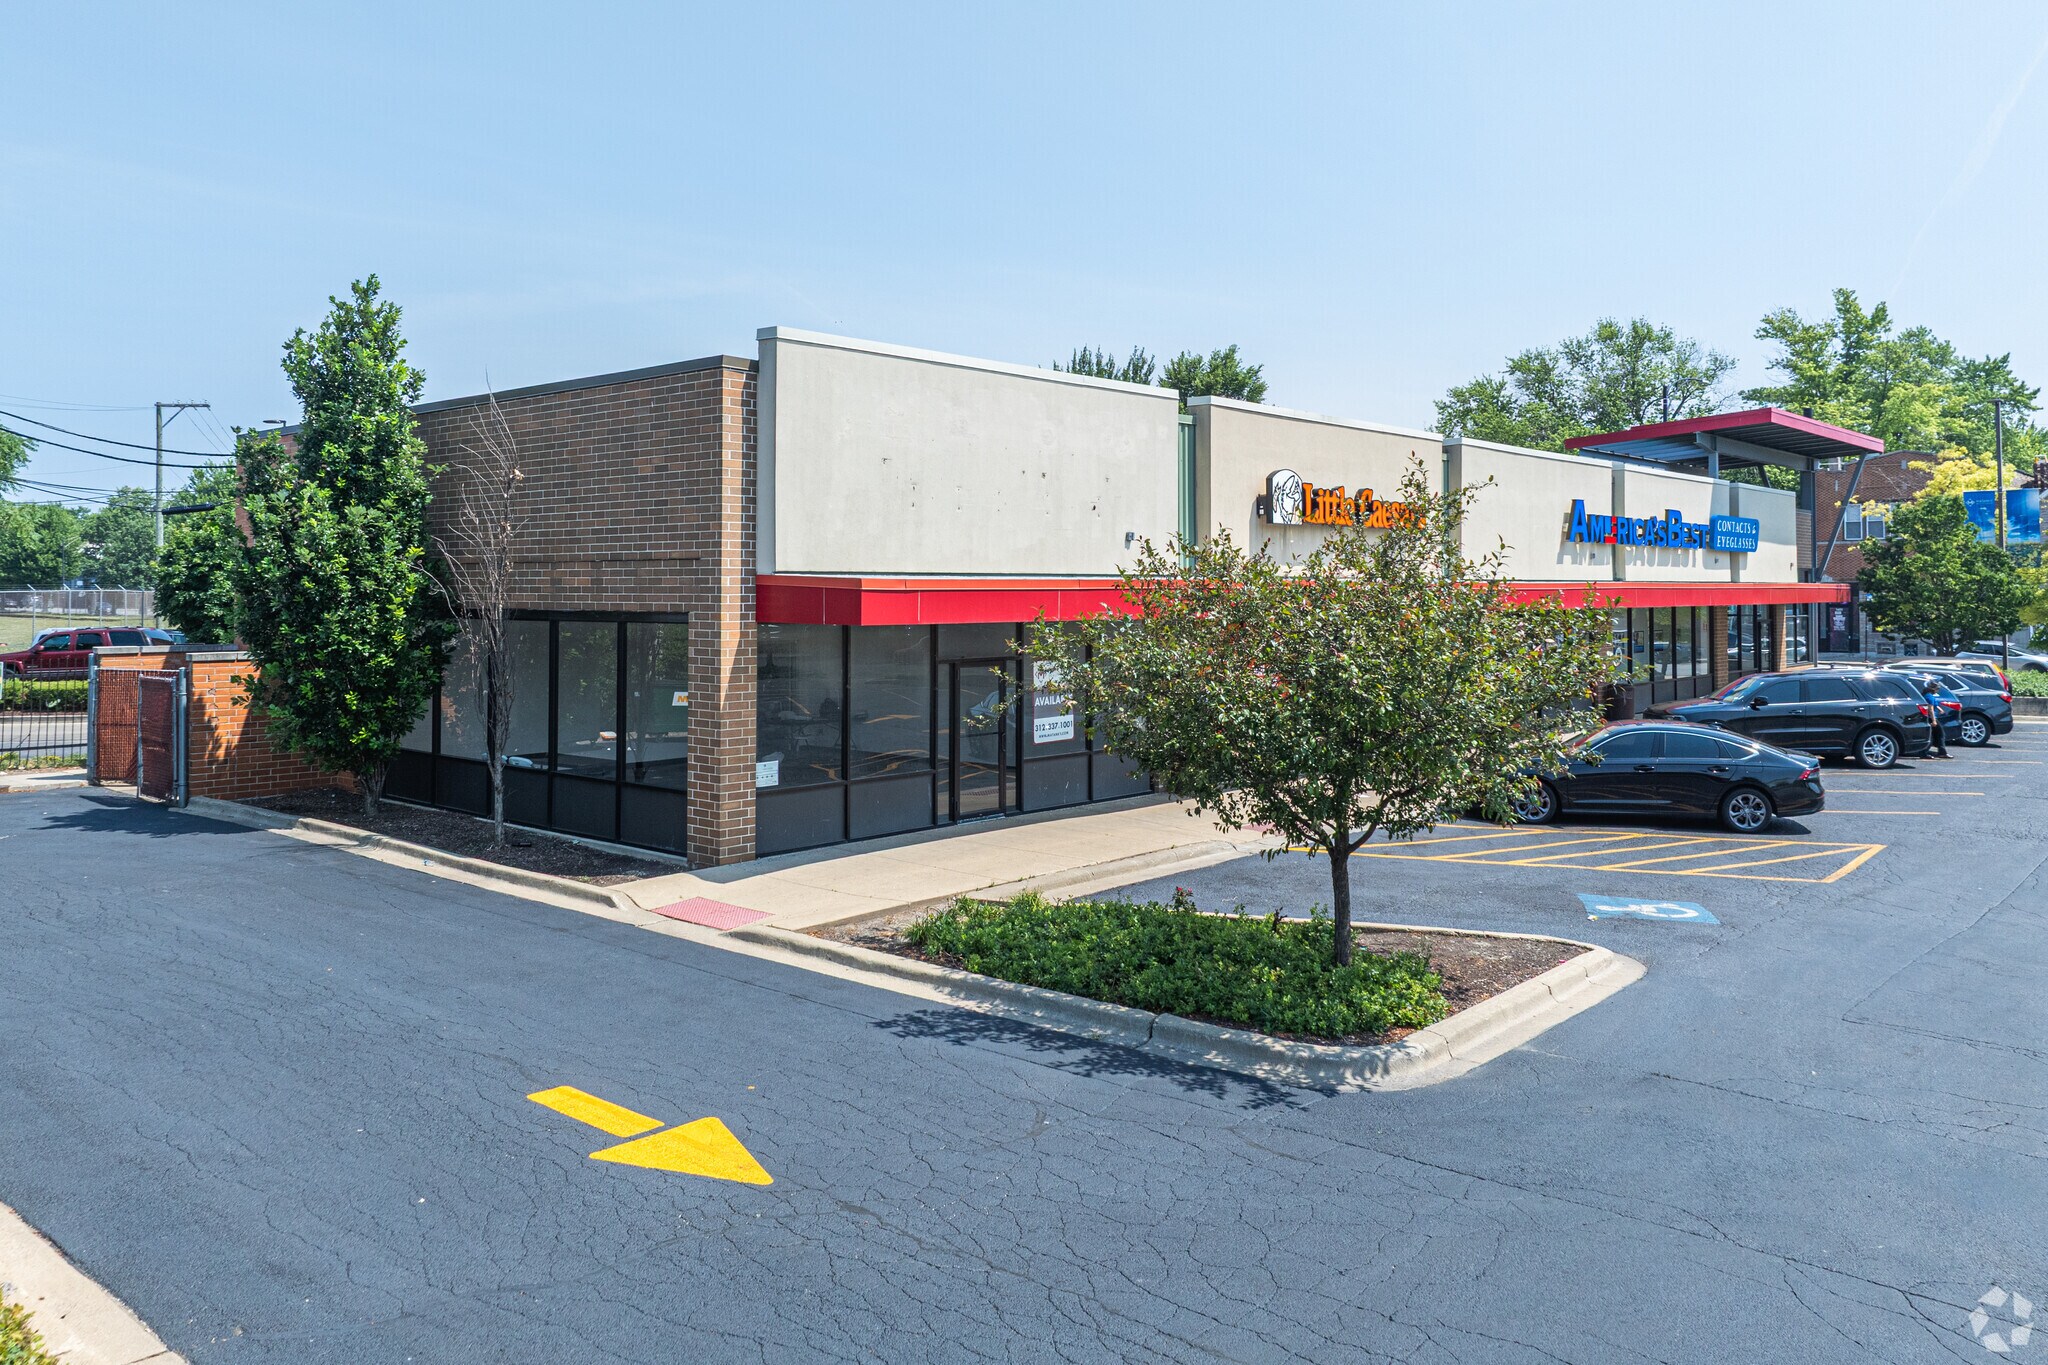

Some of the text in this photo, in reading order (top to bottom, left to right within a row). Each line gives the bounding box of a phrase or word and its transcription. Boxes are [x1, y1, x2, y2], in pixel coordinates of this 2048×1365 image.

[1302, 482, 1355, 526] Little
[1665, 509, 1709, 549] BEST
[1717, 519, 1751, 534] CONTACTS
[1716, 535, 1756, 550] EYEGLASSES
[1034, 693, 1072, 706] AVAILABE
[1035, 721, 1072, 731] 312.337.1001
